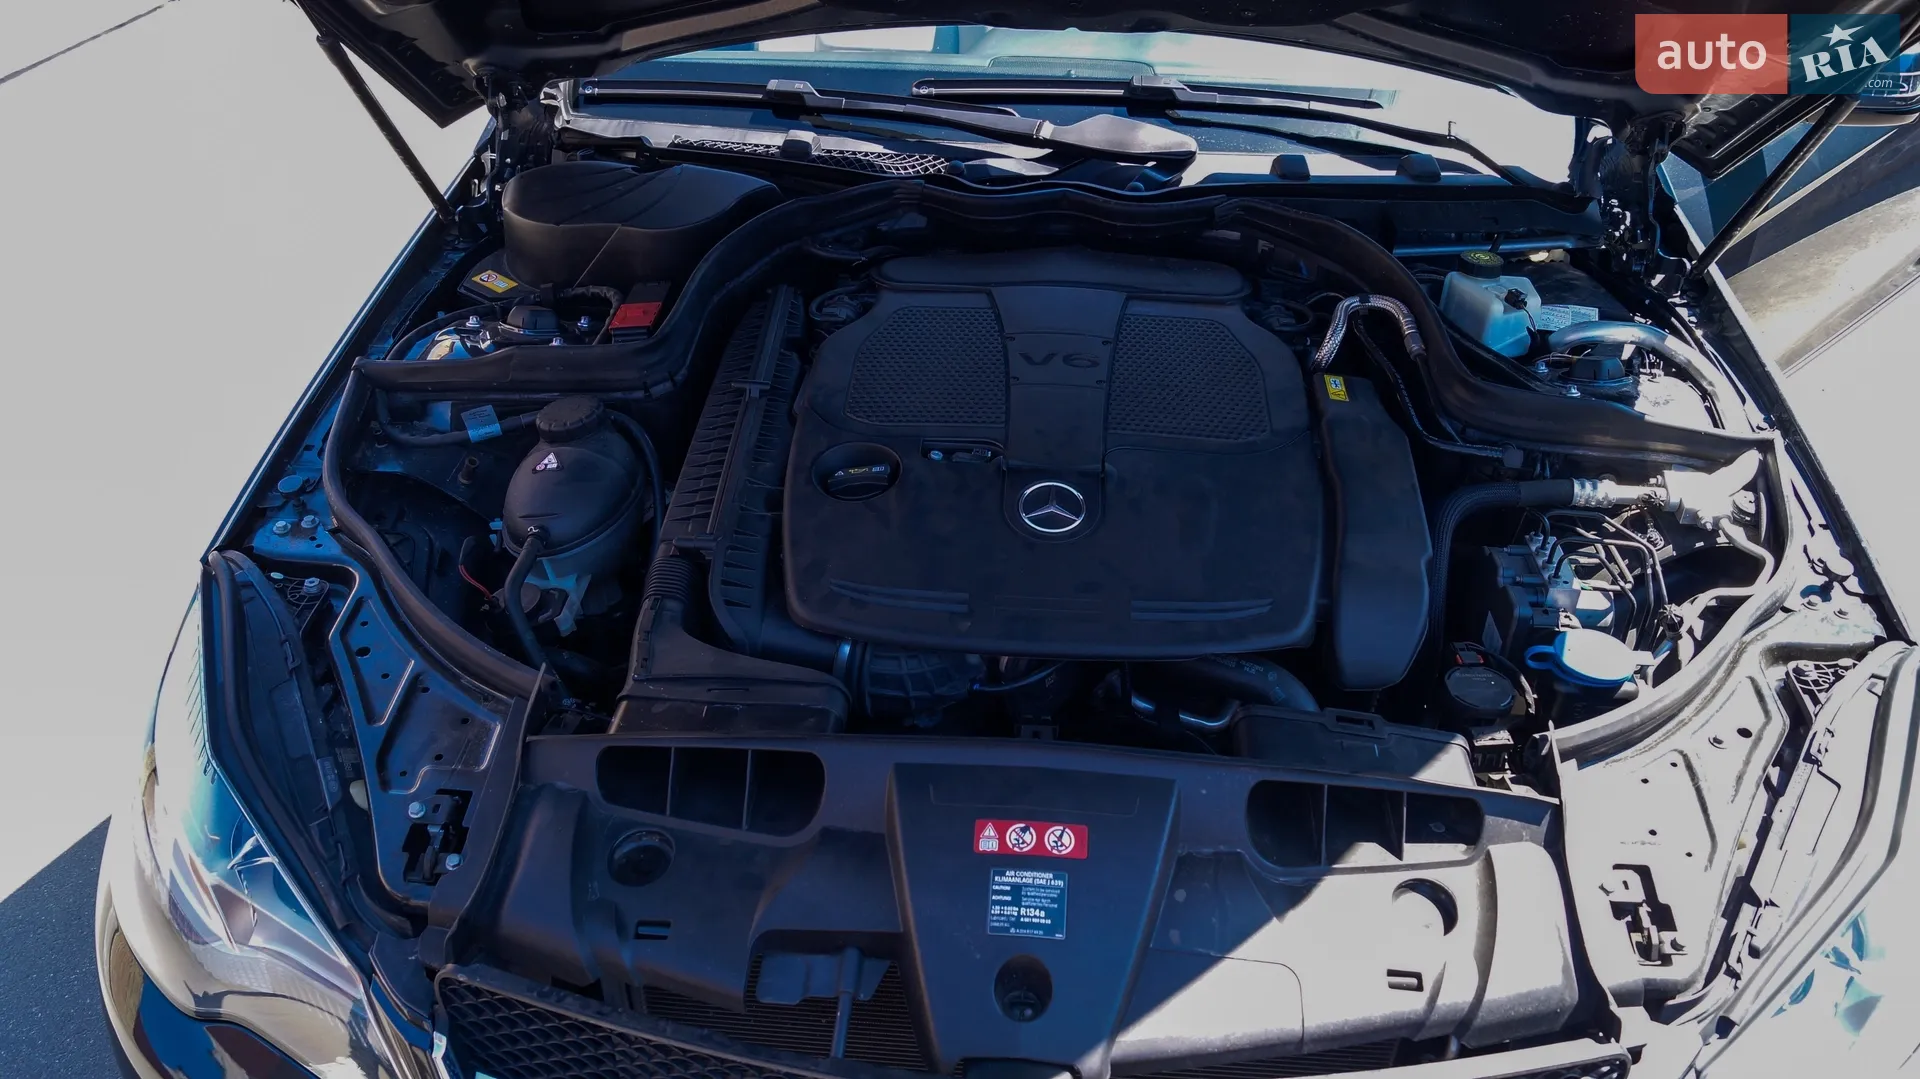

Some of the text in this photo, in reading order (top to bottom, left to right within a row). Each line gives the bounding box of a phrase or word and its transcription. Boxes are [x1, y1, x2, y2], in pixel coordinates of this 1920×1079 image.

[1018, 351, 1100, 369] V6
[1016, 871, 1053, 879] CONDITIONER
[1020, 907, 1045, 917] R134a
